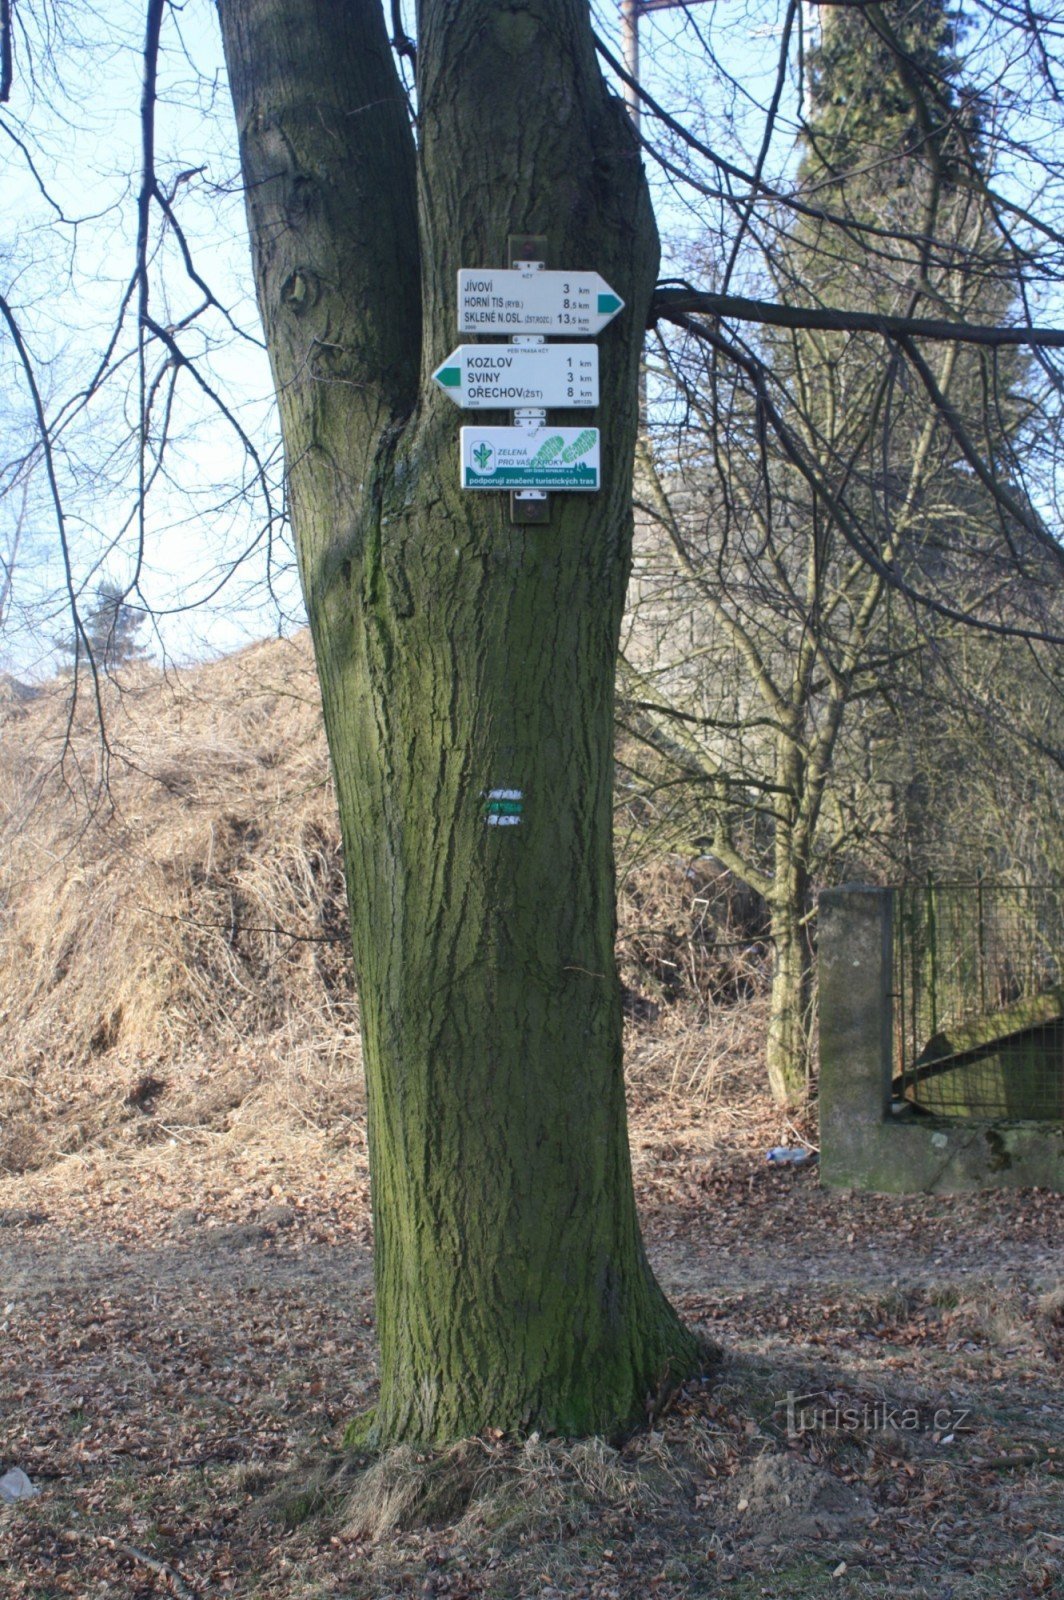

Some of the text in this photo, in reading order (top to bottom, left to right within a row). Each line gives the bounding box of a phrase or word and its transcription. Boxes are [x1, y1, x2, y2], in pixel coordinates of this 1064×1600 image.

[464, 280, 493, 292] JÍVOVÍ
[563, 284, 570, 293] 3
[464, 294, 490, 307] HORNÍ
[491, 297, 504, 308] TIS
[464, 310, 495, 322] SKLENÉ
[557, 314, 576, 324] 13,5
[467, 357, 513, 368] KOZLOV
[567, 358, 572, 367] 1
[467, 372, 500, 383] SVINY
[567, 372, 574, 383] 3
[567, 388, 574, 398] 8
[498, 448, 527, 456] ZELENÁ
[469, 476, 594, 486] podporují značení turistických tras
